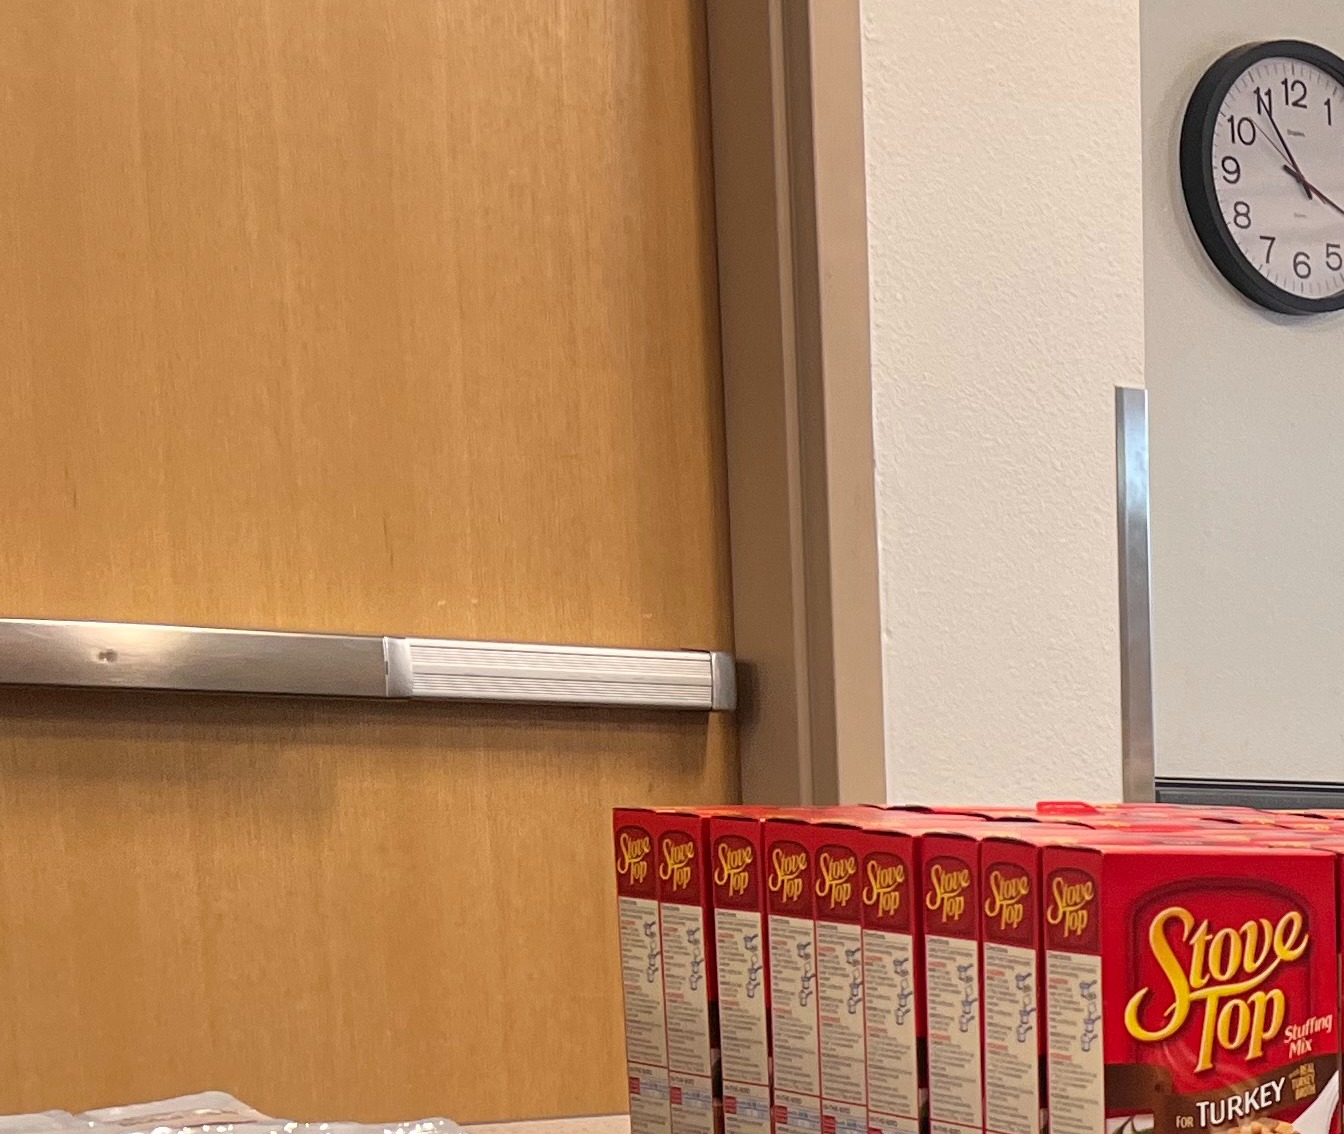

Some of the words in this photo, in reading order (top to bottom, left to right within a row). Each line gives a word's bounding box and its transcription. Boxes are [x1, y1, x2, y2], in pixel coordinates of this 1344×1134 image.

[1253, 86, 1273, 117] 11
[1281, 77, 1307, 109] 12
[1324, 98, 1332, 126] 1
[1227, 115, 1256, 146] 10
[1221, 156, 1241, 184] 9
[1233, 201, 1251, 229] 8
[1259, 235, 1276, 264] 7
[1293, 251, 1312, 279] 6
[1325, 242, 1342, 271] 5
[618, 833, 650, 874] Stove
[660, 839, 694, 880] Stove
[714, 843, 753, 885] Stove
[630, 859, 647, 885] Top
[769, 848, 807, 892] Stove
[816, 853, 857, 897] Stove
[862, 860, 905, 905] Stove
[926, 864, 970, 910] Stove
[985, 871, 1029, 917] Stove
[1047, 877, 1094, 924] Stove
[1063, 906, 1088, 938] Top
[1124, 906, 1309, 1042] Stove
[1190, 986, 1286, 1074] Top
[1284, 1013, 1333, 1044] Stuffing
[1289, 1037, 1313, 1060] Mix
[1196, 1077, 1286, 1127] TURKEY
